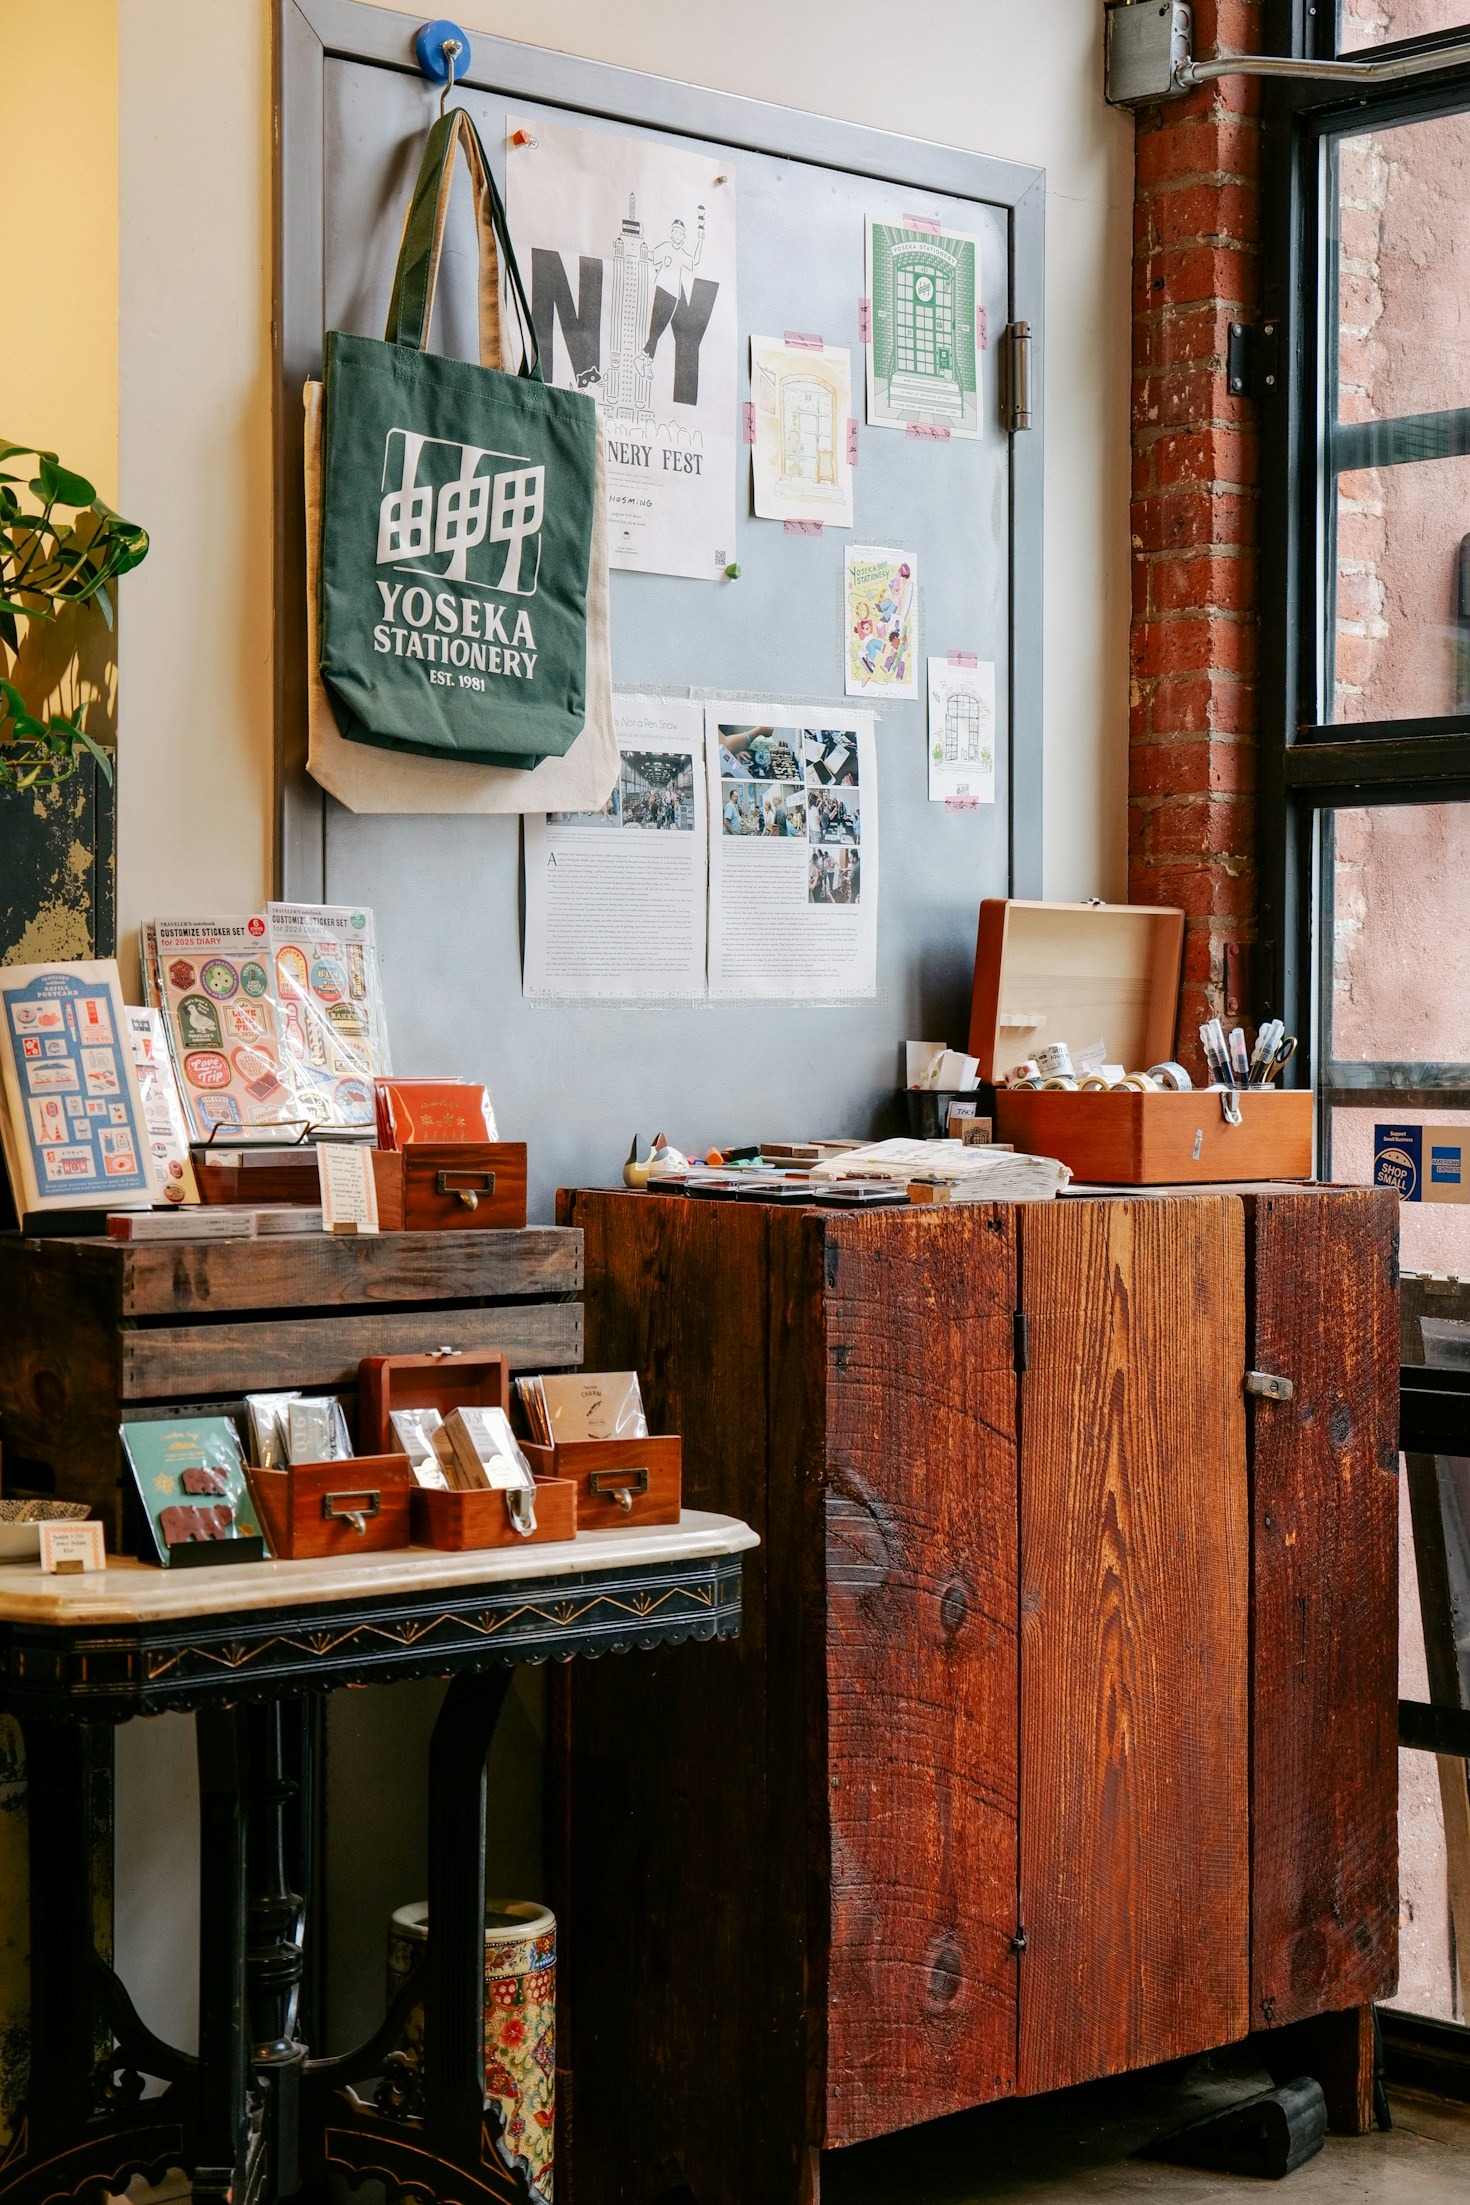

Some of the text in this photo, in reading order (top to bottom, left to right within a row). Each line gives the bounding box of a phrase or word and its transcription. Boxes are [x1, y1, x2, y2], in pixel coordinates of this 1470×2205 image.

[892, 243, 956, 264] YOSEKA STATIONERY
[662, 449, 703, 475] FEST
[848, 566, 876, 586] YOSEKA
[857, 570, 889, 584] STATIONERY
[376, 581, 537, 650] YOSEKA
[373, 624, 538, 680] STATIONERY
[429, 669, 486, 692] EST. 1981
[621, 716, 636, 727] Not
[644, 718, 657, 729] Pen
[659, 719, 678, 730] Show
[547, 852, 557, 866] A
[253, 919, 259, 927] 6
[309, 917, 335, 927] STICKER
[336, 919, 348, 927] SET
[160, 928, 199, 938] CUSTOMIZE
[201, 928, 231, 937] STICKER
[232, 927, 245, 936] SET
[196, 938, 221, 946] DIARY
[37, 990, 79, 998] POSTCARD
[191, 1058, 218, 1071] Love
[198, 1070, 223, 1083] Trip
[1381, 1163, 1408, 1178] SHOP
[1377, 1171, 1407, 1190] SMALL
